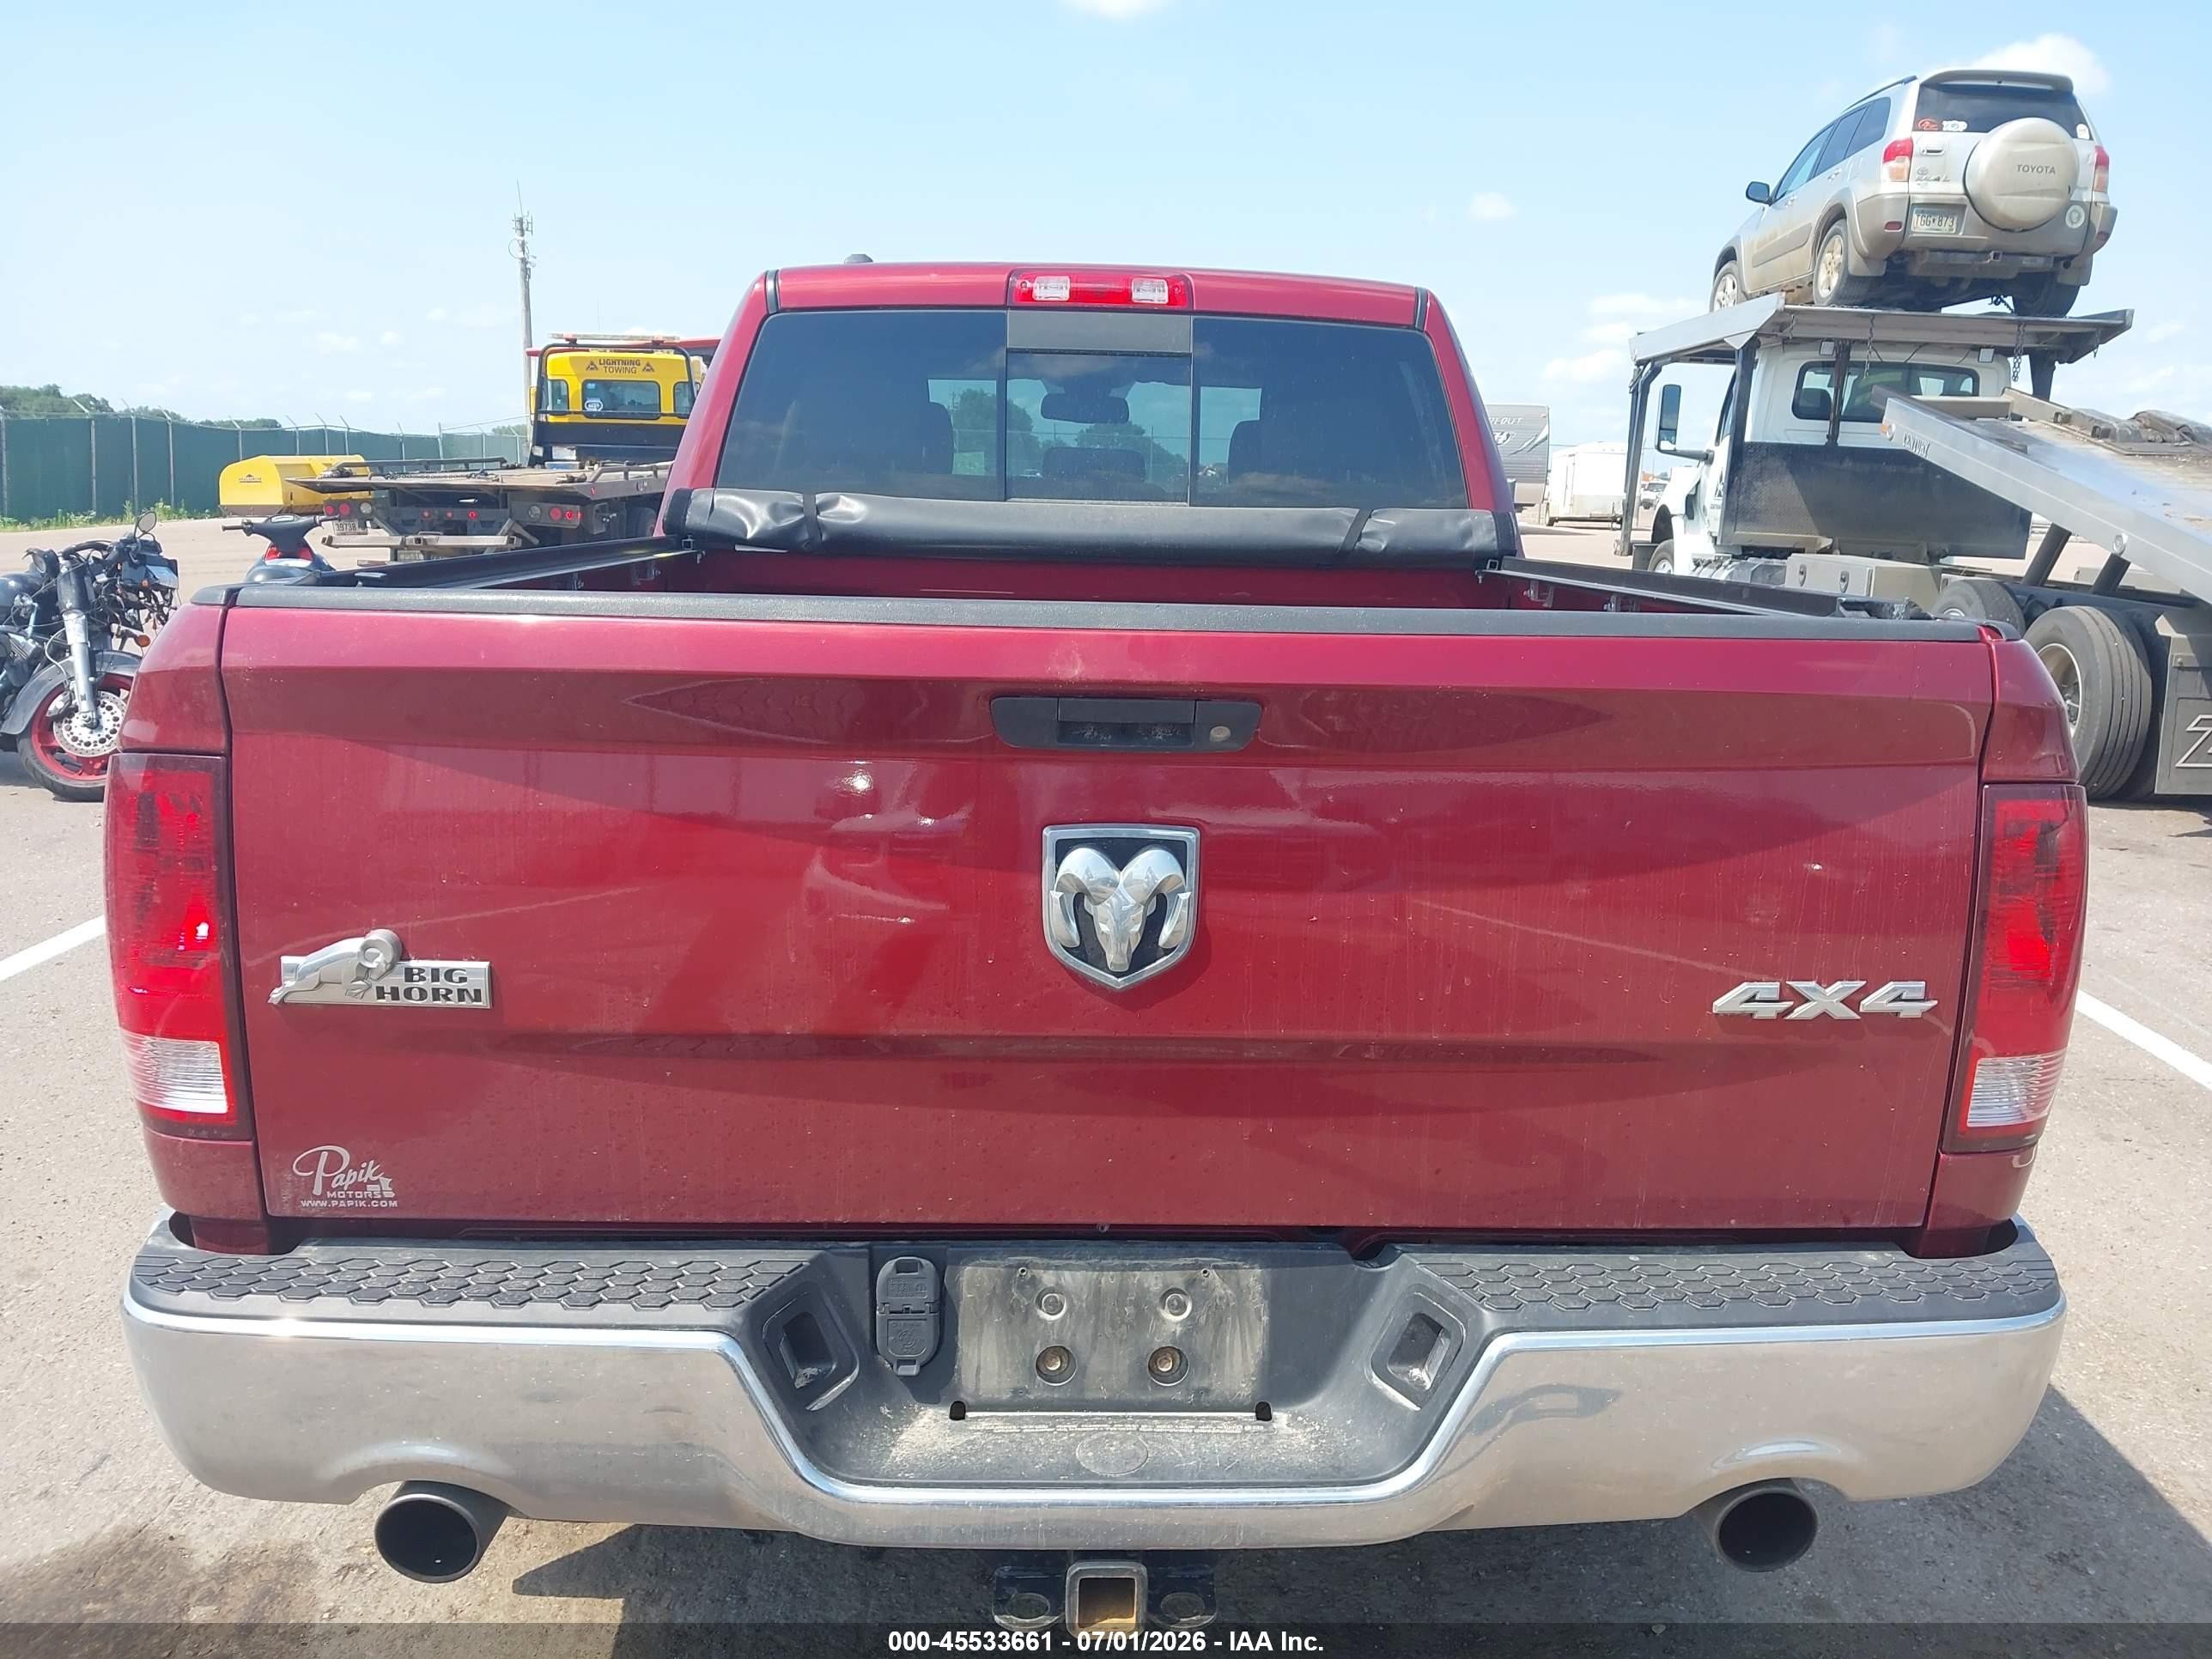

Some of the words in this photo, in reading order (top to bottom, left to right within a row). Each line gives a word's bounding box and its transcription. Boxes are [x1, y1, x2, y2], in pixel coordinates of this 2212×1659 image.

[2017, 164, 2057, 175] TOYOTA
[604, 366, 637, 374] TOWING
[404, 967, 468, 984] BIG
[375, 985, 483, 1004] HORN
[1712, 980, 1938, 1020] 4X4
[293, 1145, 385, 1196] Papik
